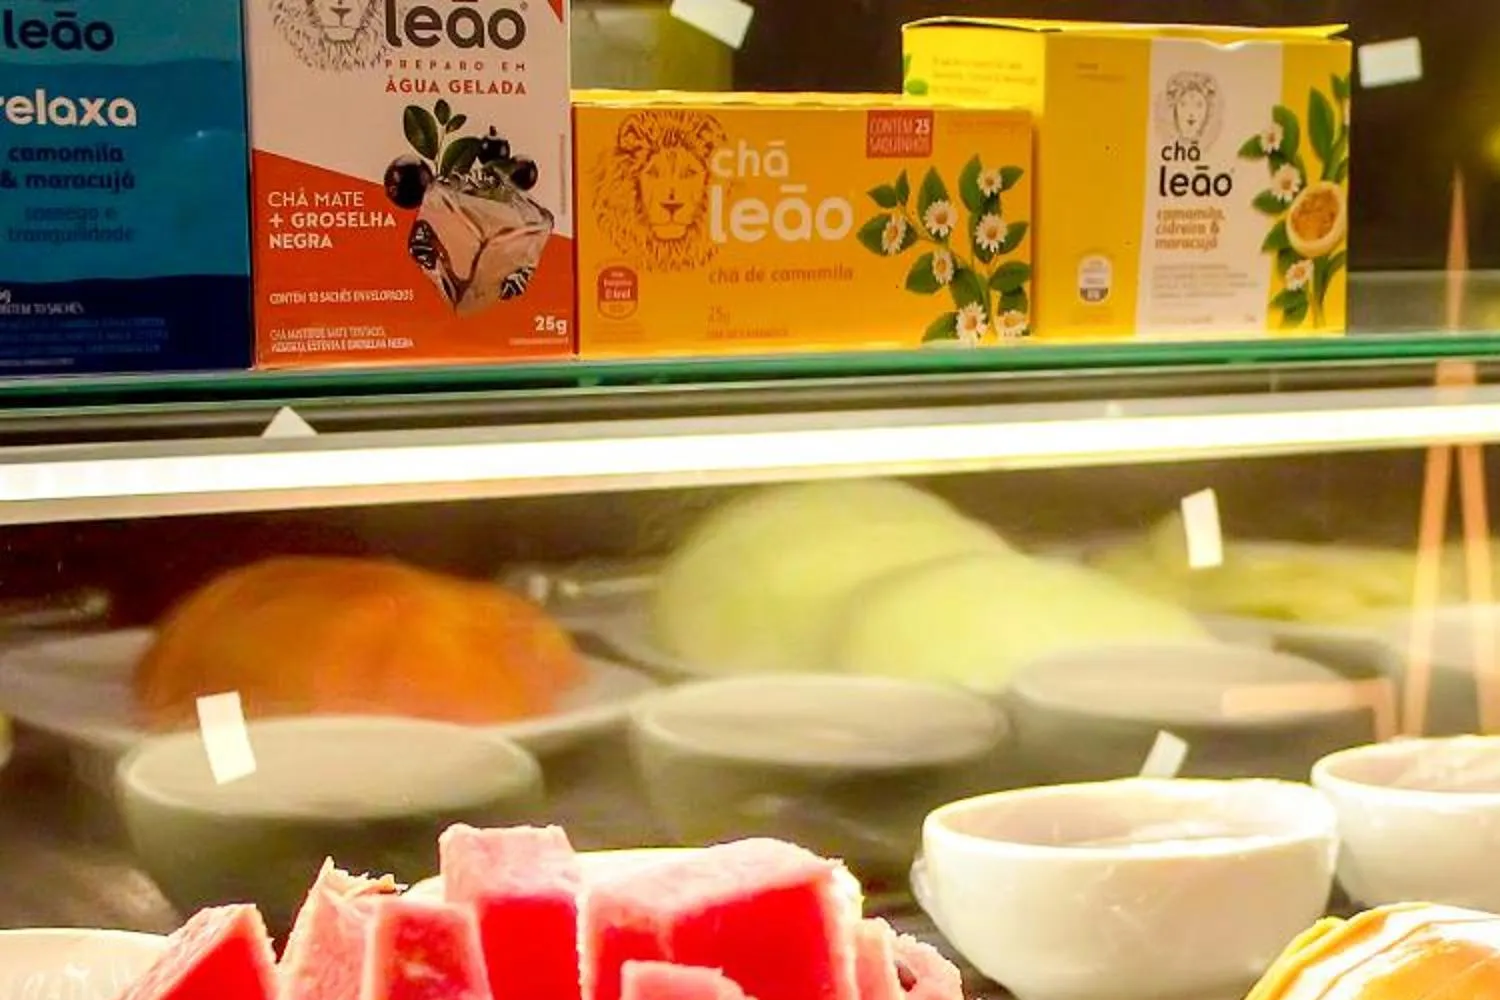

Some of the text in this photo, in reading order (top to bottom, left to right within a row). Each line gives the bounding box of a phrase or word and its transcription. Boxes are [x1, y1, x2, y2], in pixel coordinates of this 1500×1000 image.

[385, 59, 526, 72] PREPARO EM
[385, 75, 527, 95] ÁGUA GELADA
[914, 118, 930, 134] 25
[8, 143, 124, 163] camomila
[0, 169, 136, 194] & maracujá
[268, 187, 365, 207] CHÁ MATE
[269, 211, 397, 229] + GROSELHA
[269, 232, 333, 249] NEGRA
[1155, 235, 1217, 251] maracujá
[744, 265, 764, 283] de
[771, 262, 854, 282] camomila
[535, 314, 568, 335] 25g
